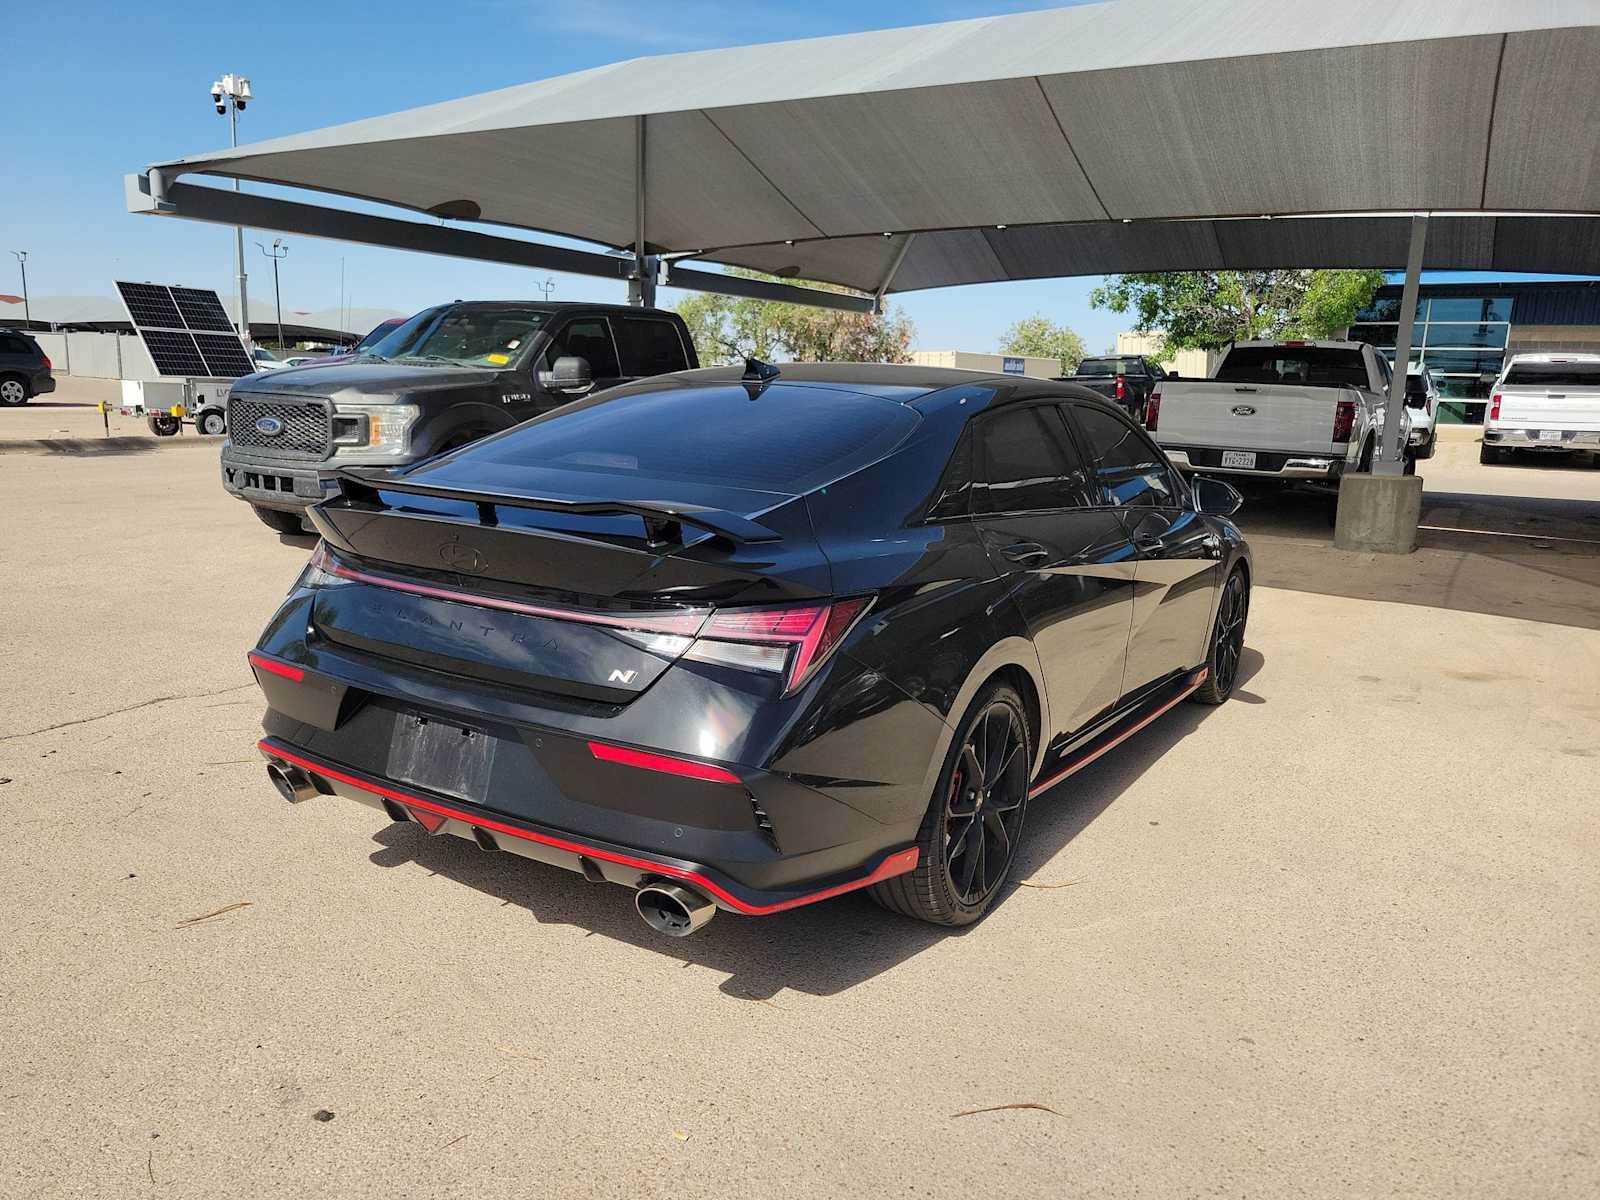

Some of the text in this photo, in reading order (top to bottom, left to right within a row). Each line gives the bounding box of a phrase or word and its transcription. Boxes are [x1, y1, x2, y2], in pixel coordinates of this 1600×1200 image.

[259, 420, 278, 431] Ford
[373, 603, 560, 650] ELANTRA
[608, 669, 638, 684] N
